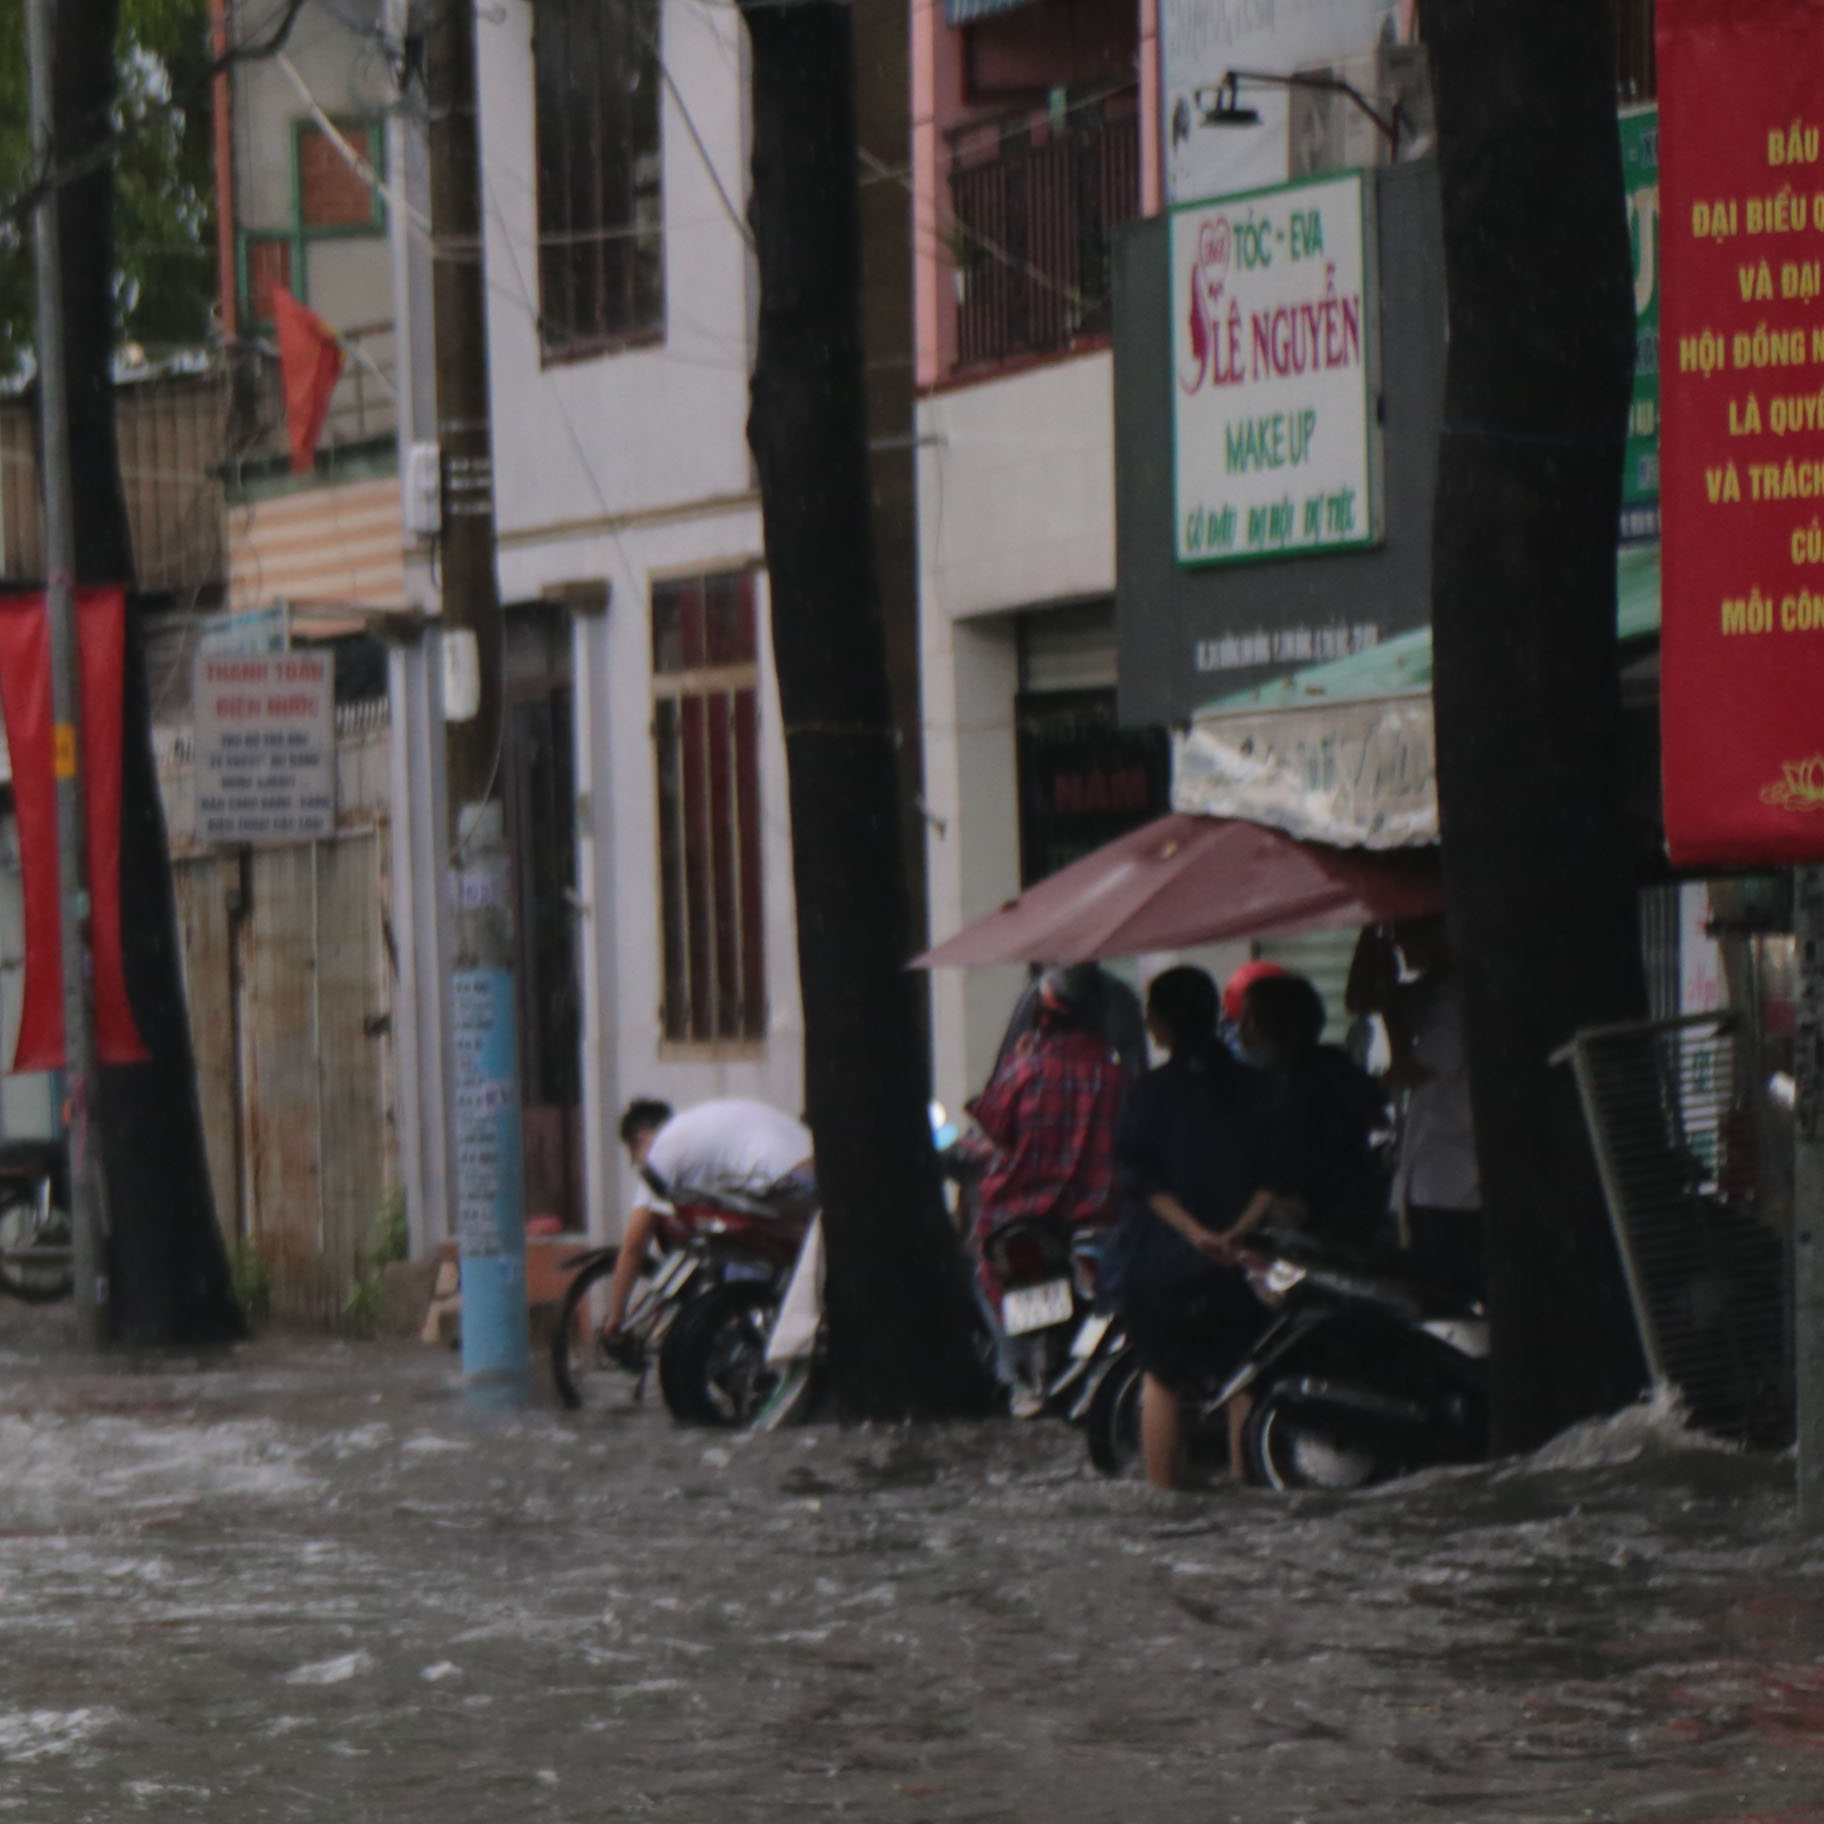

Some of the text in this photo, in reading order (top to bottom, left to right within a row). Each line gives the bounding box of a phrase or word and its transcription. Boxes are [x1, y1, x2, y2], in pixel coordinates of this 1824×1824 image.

[1234, 211, 1272, 270] TÓC
[1290, 209, 1324, 262] EVA
[1692, 198, 1738, 244] ĐẠI
[1746, 182, 1808, 235] BIỂU
[1738, 257, 1821, 305] VÀ ĐẠI
[1212, 263, 1362, 387] LÊ NGUYỄN
[1679, 326, 1725, 378] HỘI
[1226, 408, 1317, 475] MAKE UP
[1728, 390, 1763, 437] LÀ
[1705, 457, 1741, 505] VÀ
